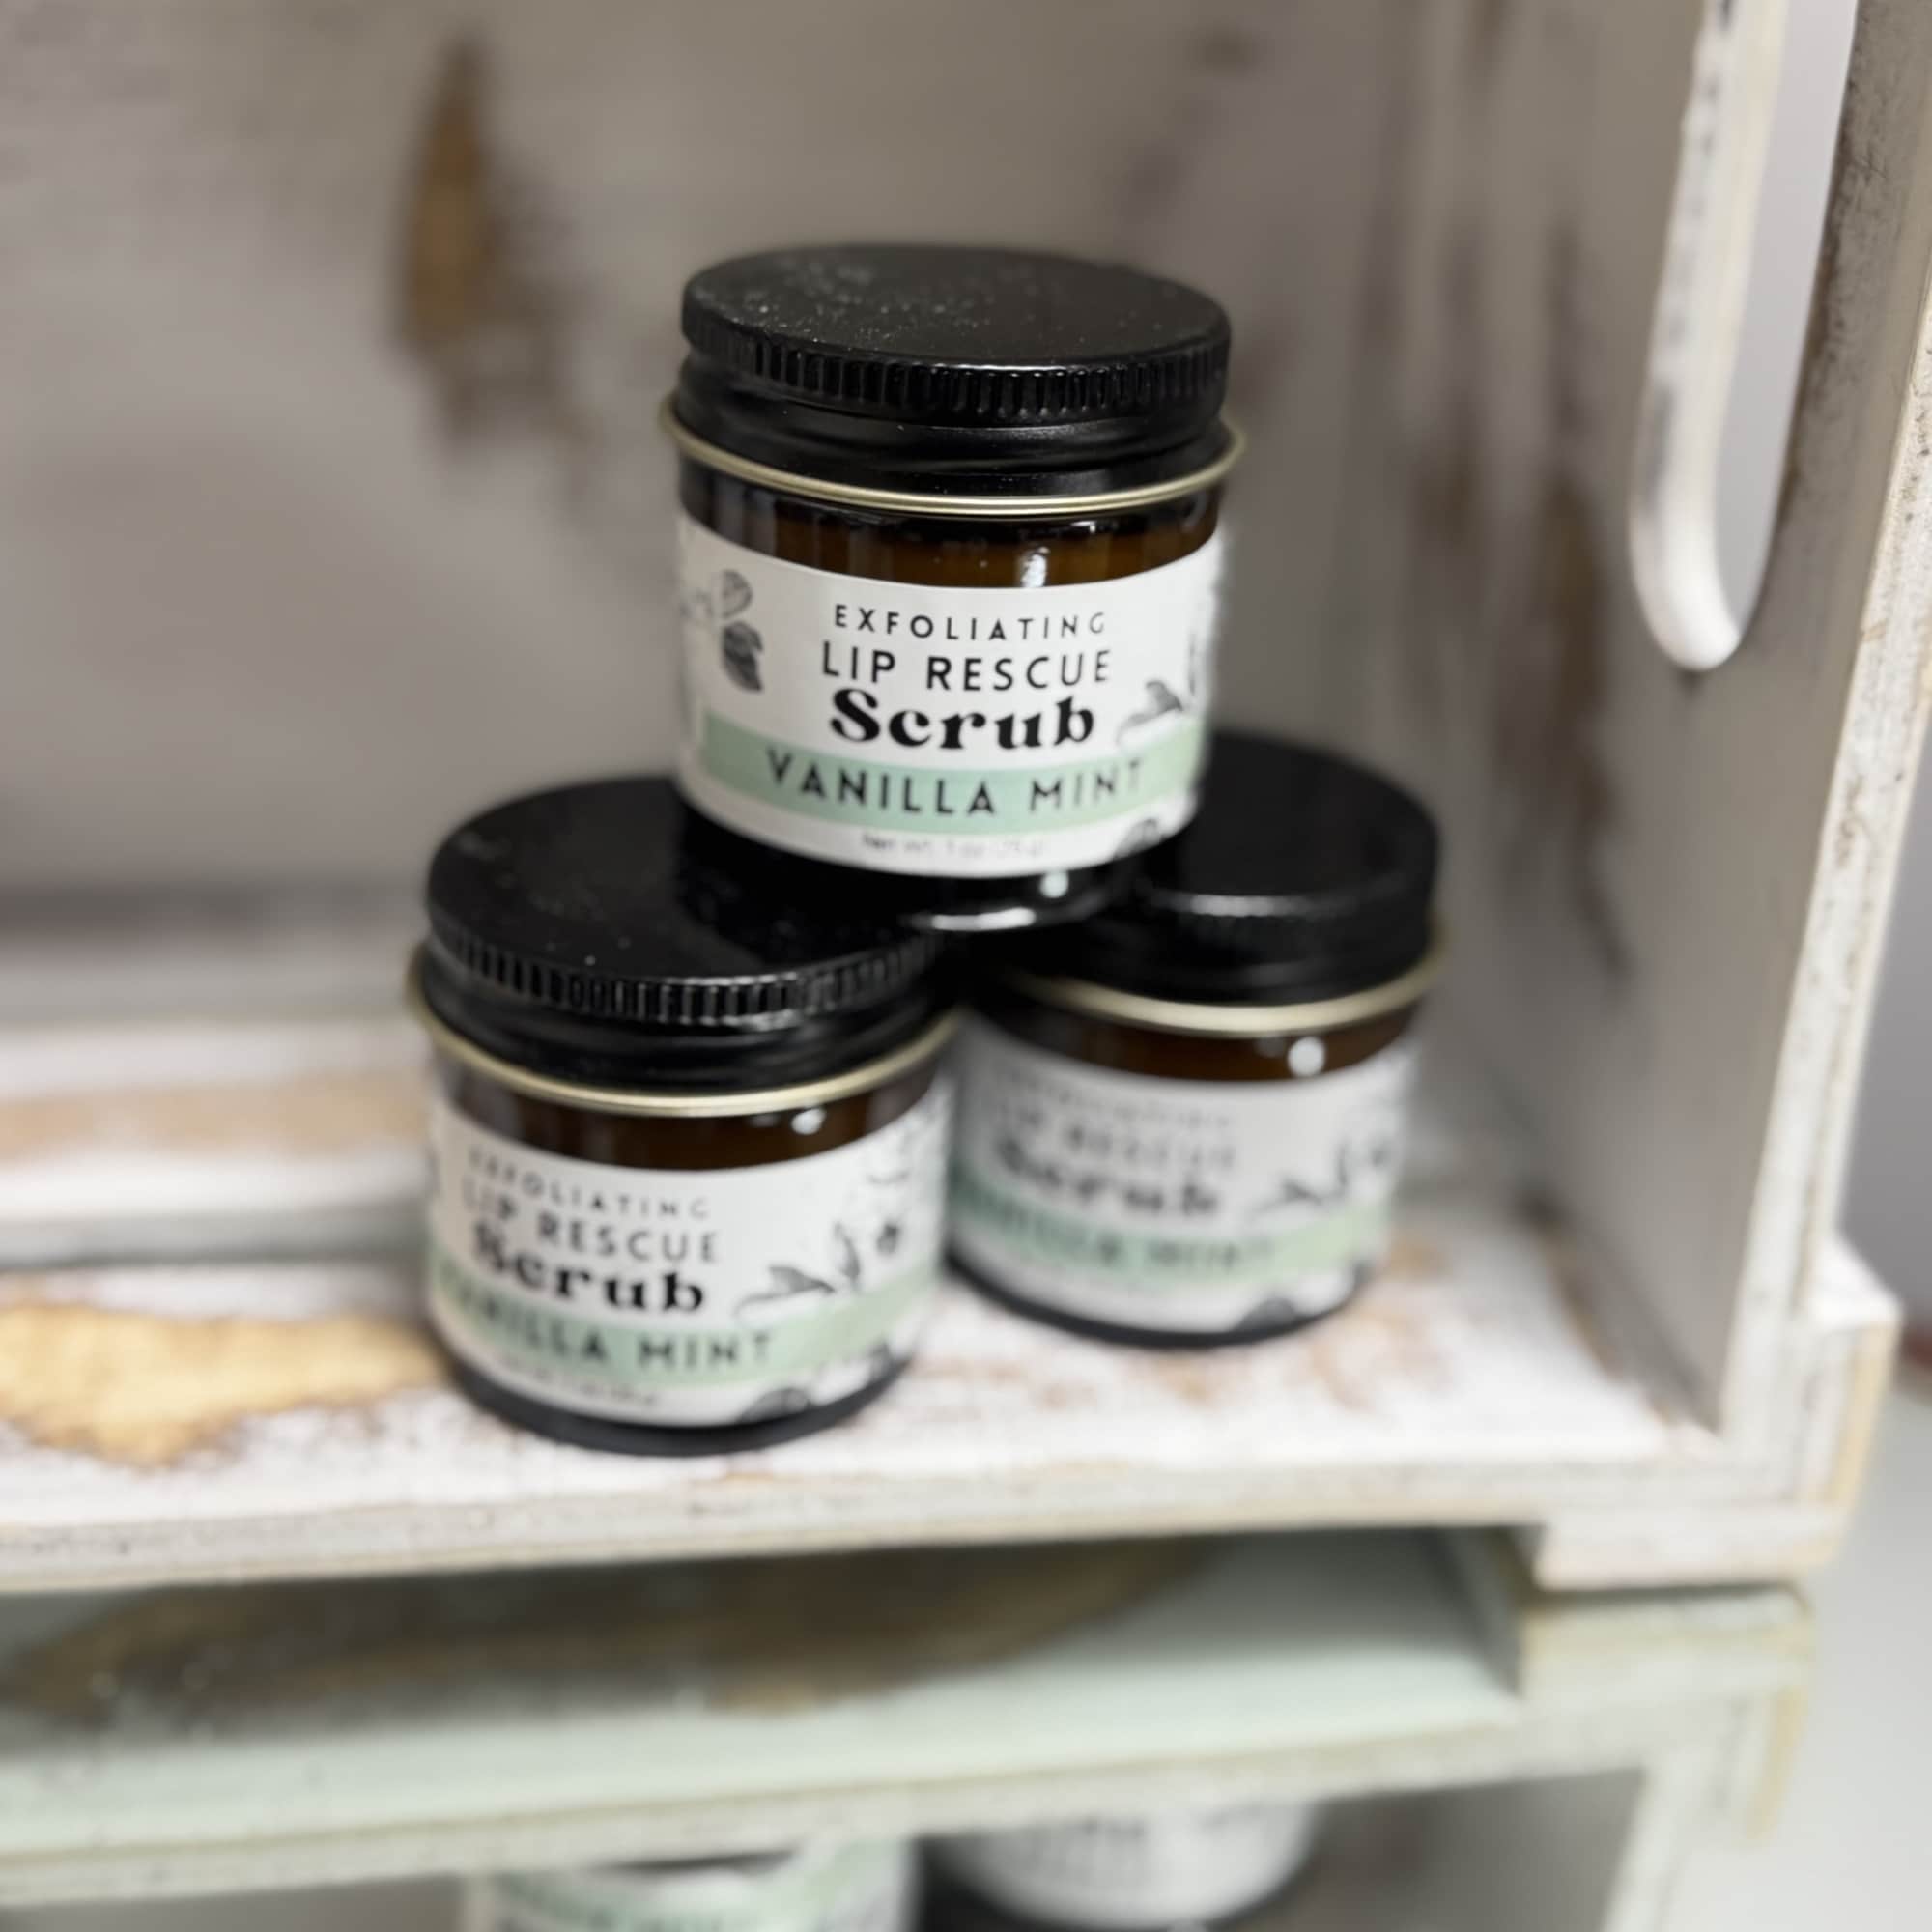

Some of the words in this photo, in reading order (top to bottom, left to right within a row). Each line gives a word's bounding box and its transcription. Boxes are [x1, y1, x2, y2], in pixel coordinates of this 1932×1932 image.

[835, 604, 1106, 641] EXFOLIATING
[822, 641, 896, 683] LIP
[926, 649, 1112, 693] RESCUE
[830, 688, 1094, 750] Scrub
[766, 750, 996, 815] VANILLA
[1029, 761, 1144, 811] MINT
[537, 1210, 719, 1264] RESCUE
[475, 1218, 706, 1312] Scrub
[637, 1330, 773, 1368] MINT
